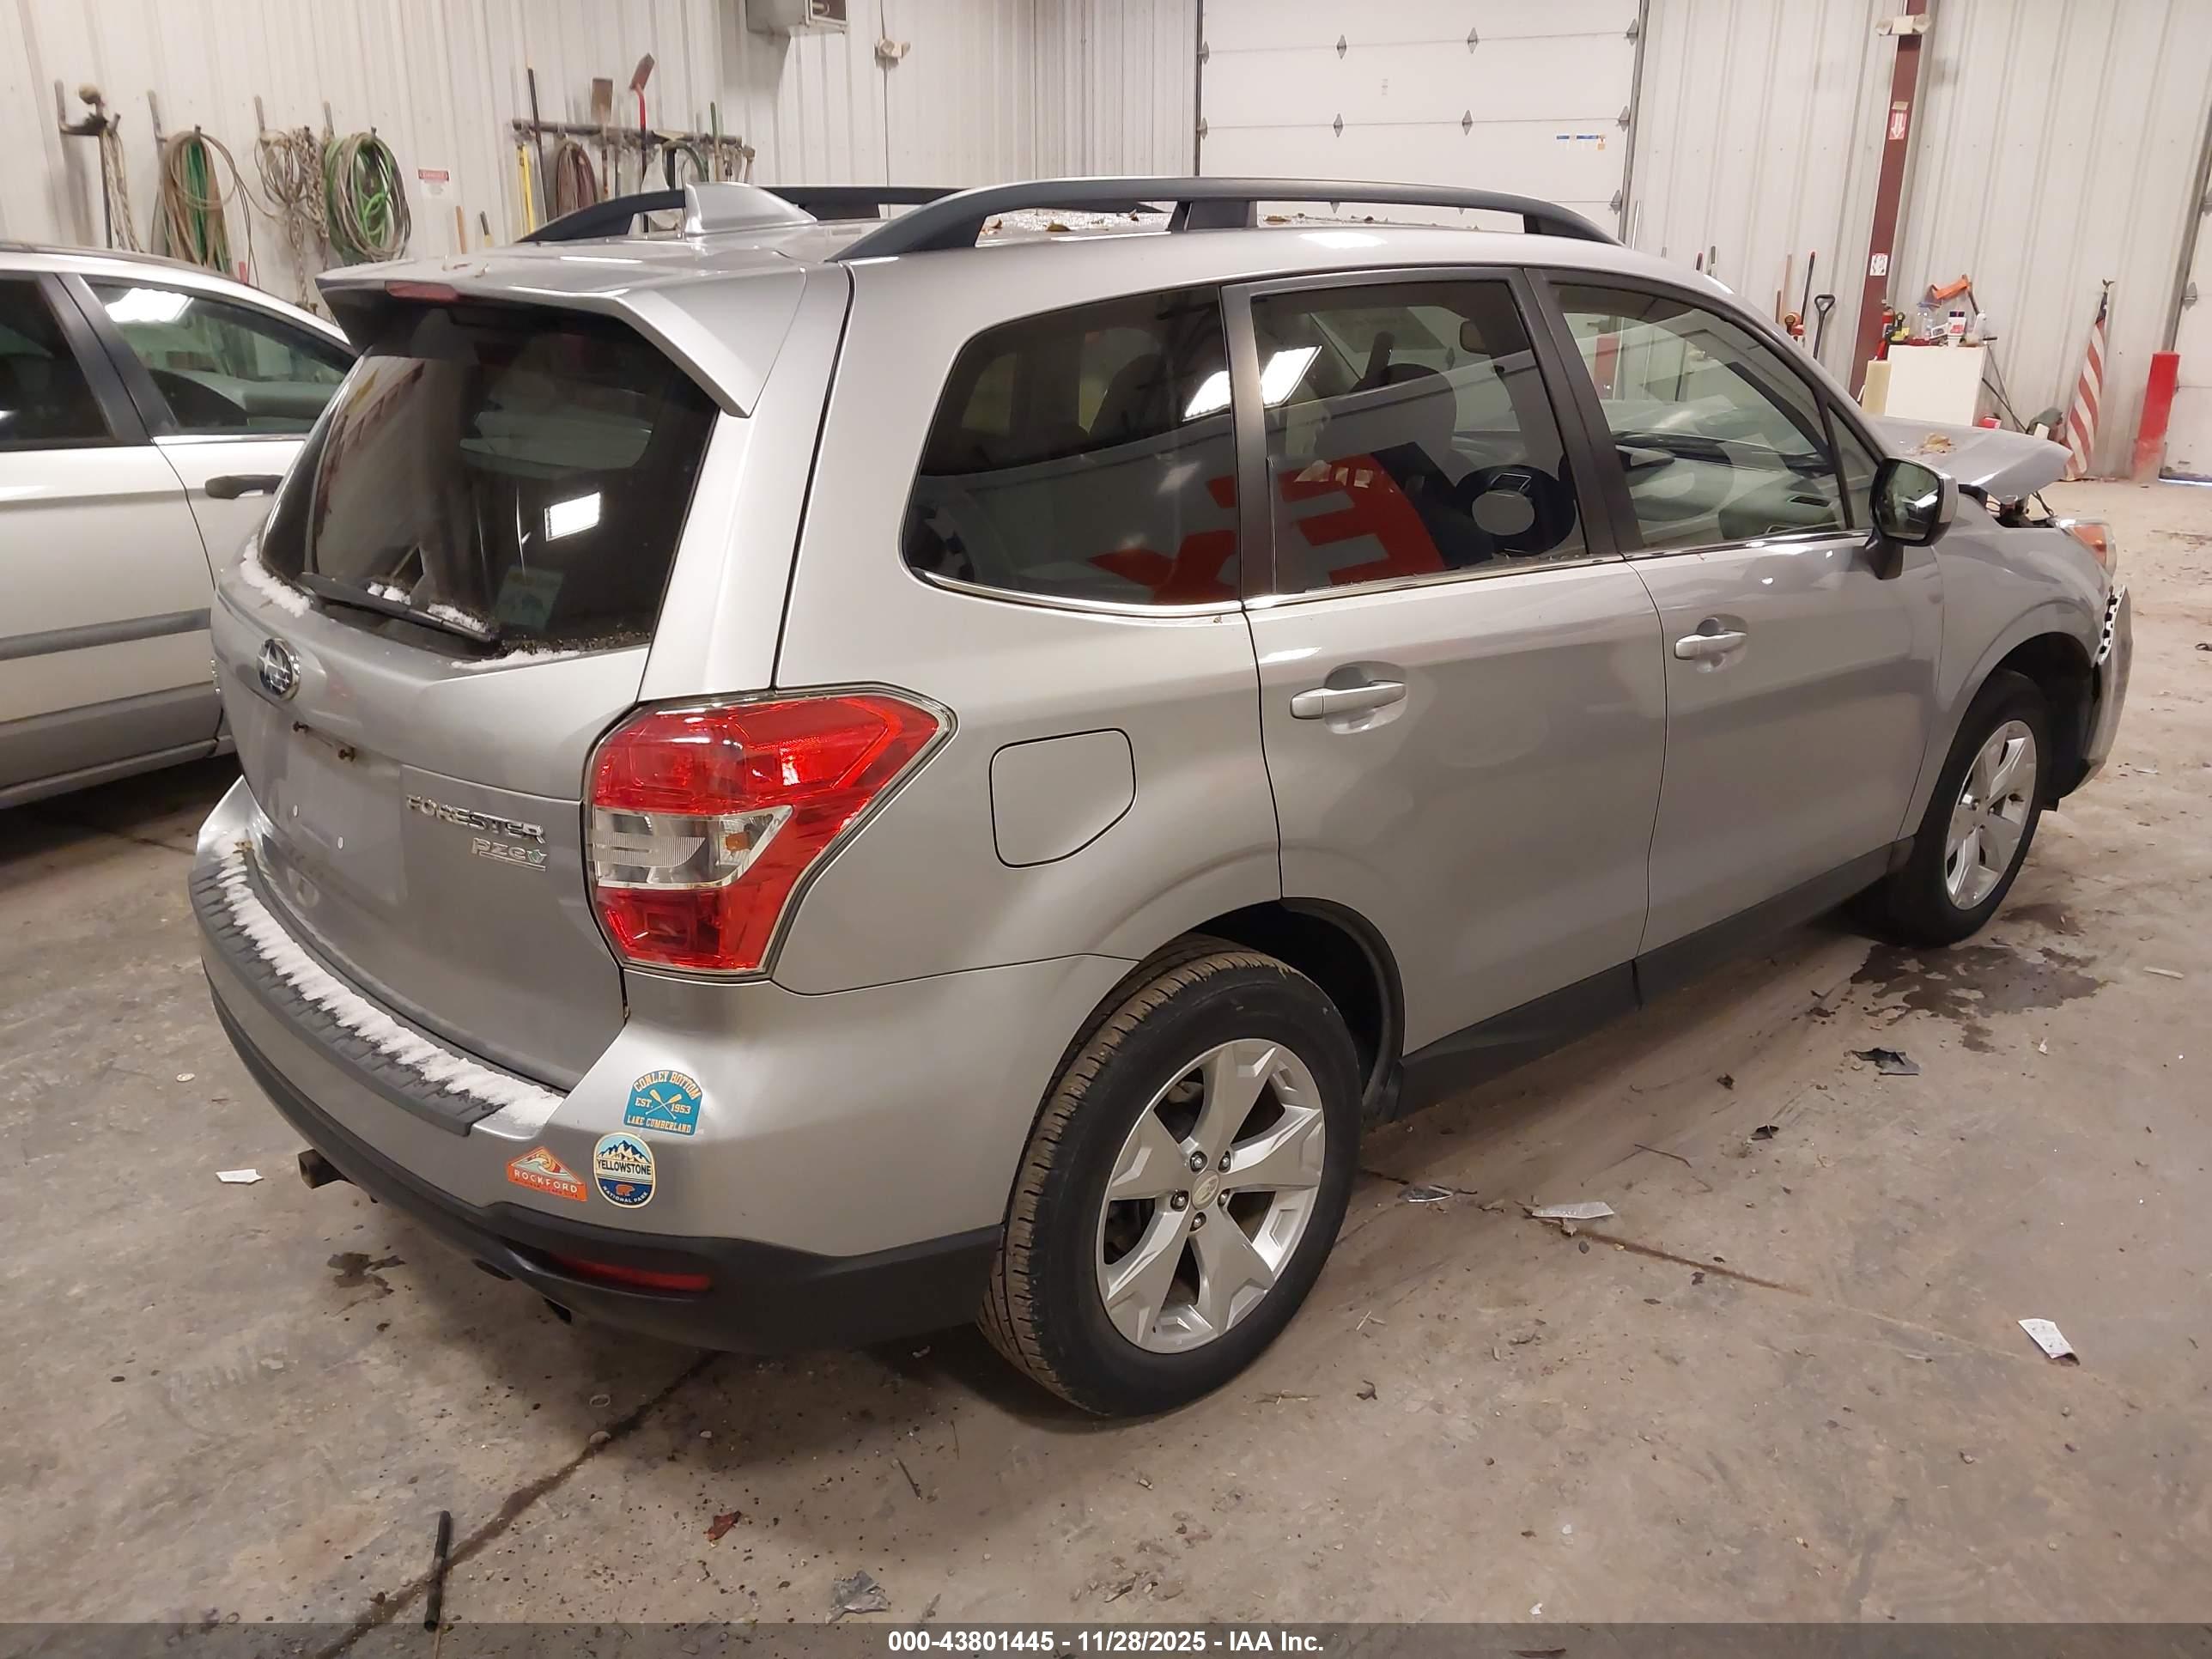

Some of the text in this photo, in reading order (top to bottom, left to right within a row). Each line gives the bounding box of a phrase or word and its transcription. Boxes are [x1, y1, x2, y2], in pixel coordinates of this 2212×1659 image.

[406, 794, 545, 844] FORESTER
[670, 1071, 702, 1100] BOTTOM
[635, 1097, 653, 1109] EST.
[627, 1115, 691, 1133] LAKE CUMBERLAND
[597, 1160, 652, 1176] YELLOWSTONE
[514, 1169, 578, 1194] ROCKFORD
[602, 1185, 648, 1203] NATIONAL PARK
